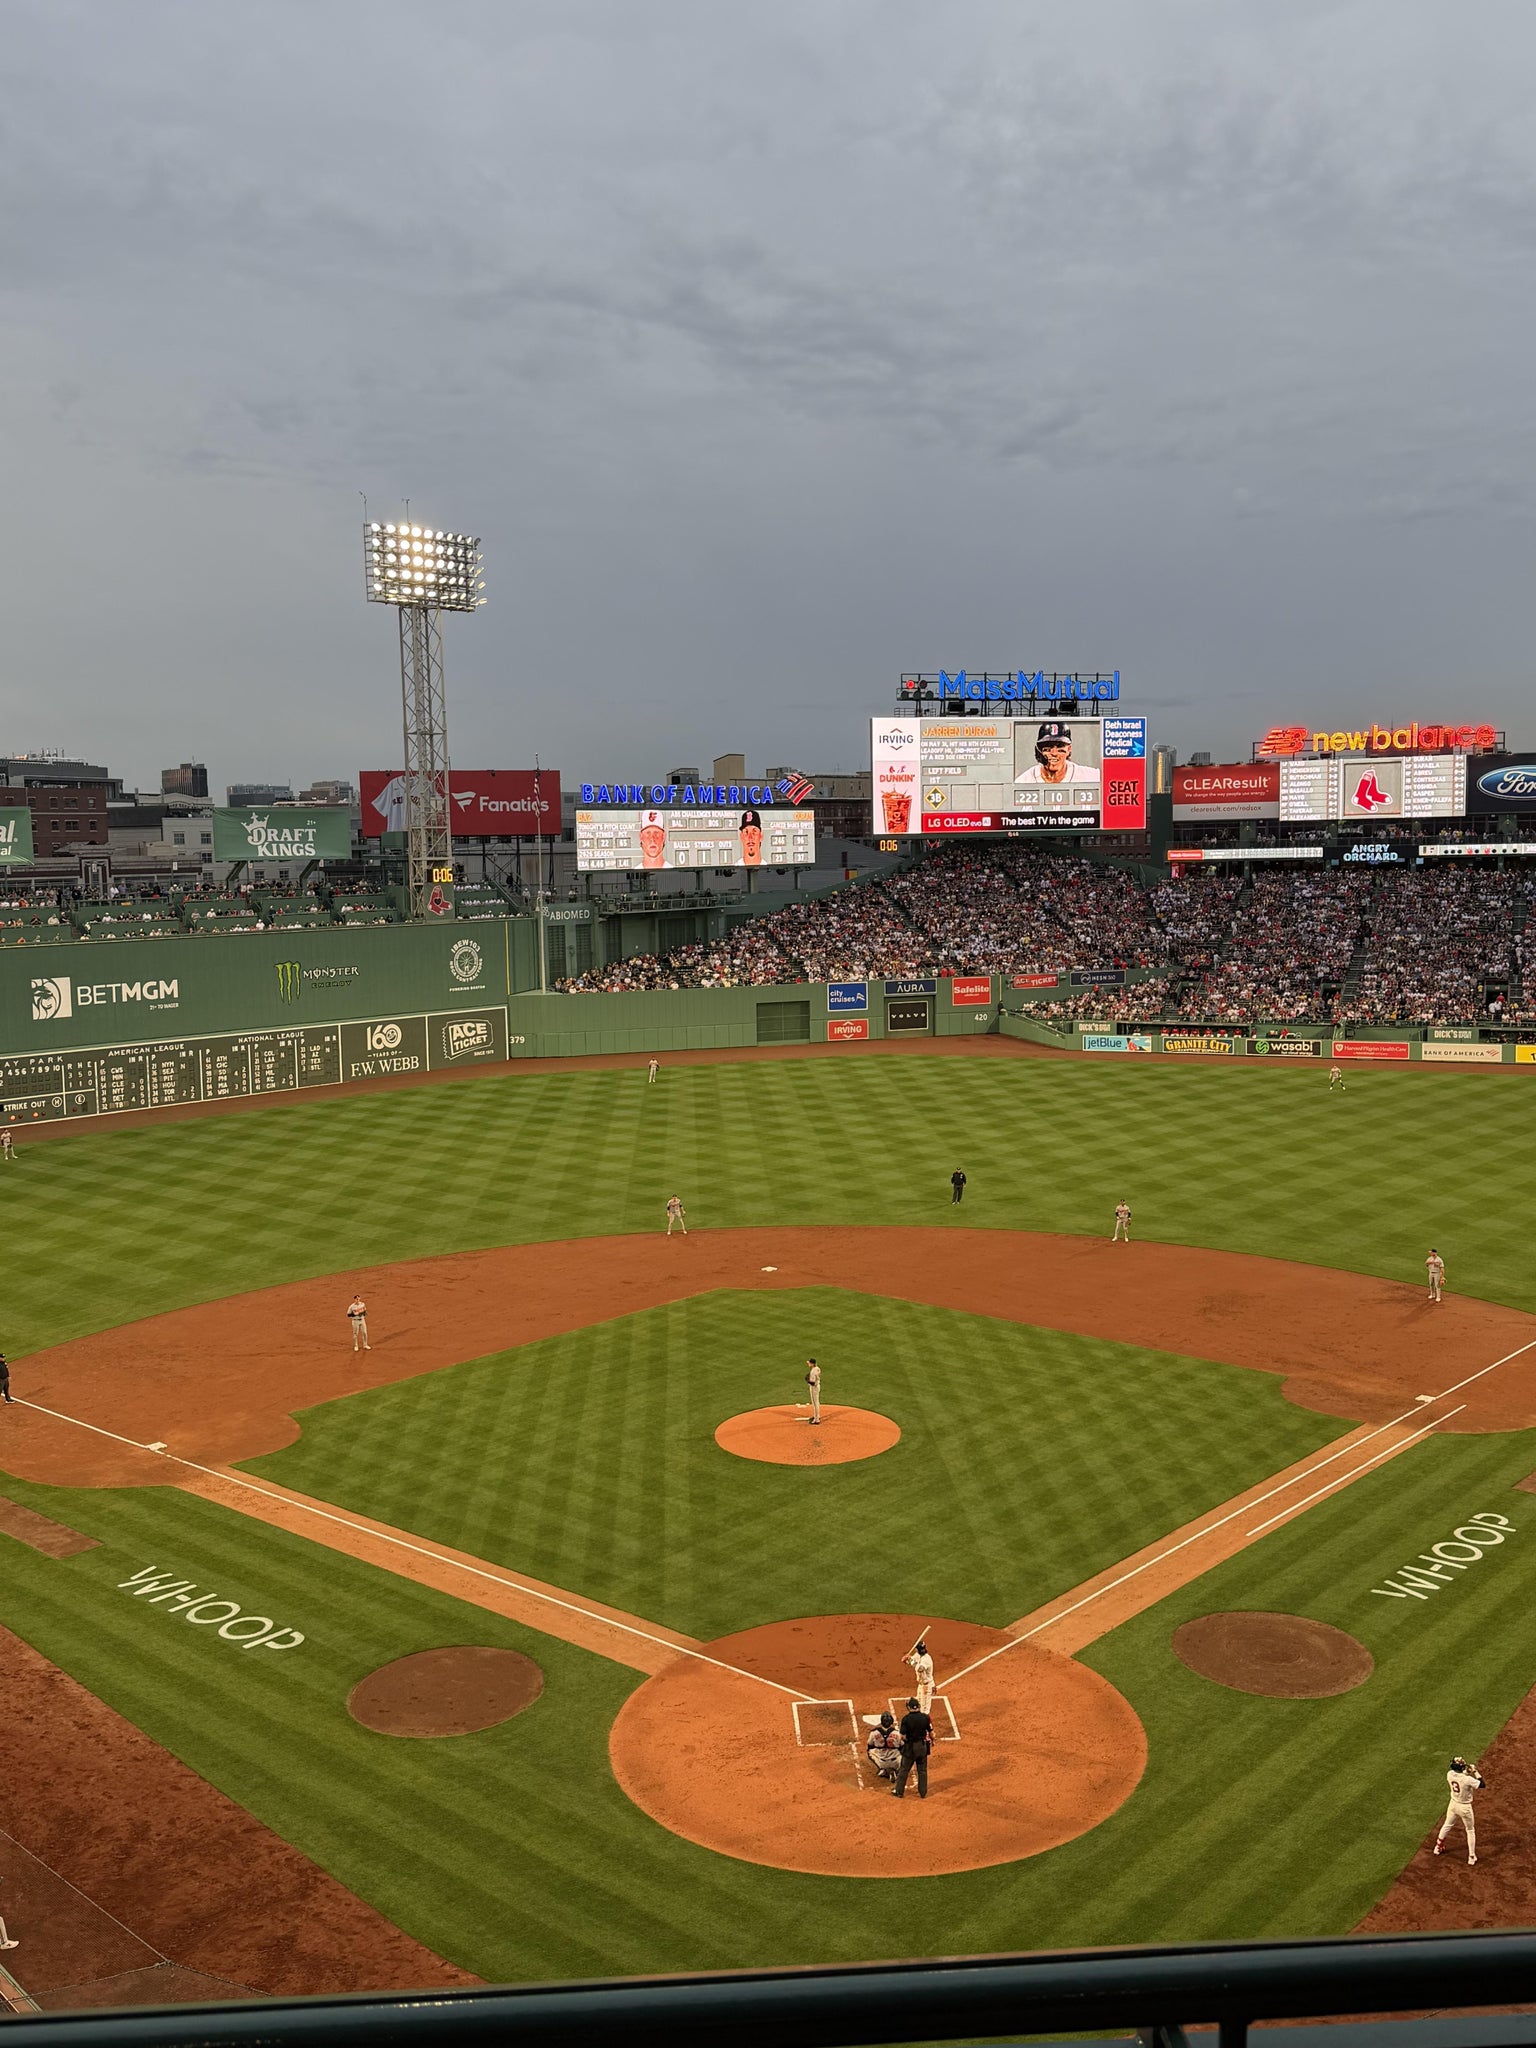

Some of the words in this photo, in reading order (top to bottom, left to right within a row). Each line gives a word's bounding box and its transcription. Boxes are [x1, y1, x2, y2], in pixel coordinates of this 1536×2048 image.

[939, 670, 1119, 699] MassMutual
[1105, 721, 1121, 729] Beth
[1123, 721, 1141, 729] Israel
[922, 726, 960, 737] JARREN
[963, 726, 996, 736] DURAN
[1105, 730, 1142, 738] Deaconess
[1313, 731, 1369, 751] new
[1372, 722, 1496, 749] balance
[879, 735, 914, 743] IRVING
[1105, 738, 1132, 747] Medical
[1105, 748, 1129, 756] Center
[1110, 781, 1138, 792] SEAT
[1183, 776, 1268, 790] CLEAResult
[582, 783, 645, 804] BANK
[650, 784, 677, 804] OF
[683, 785, 774, 804] AMERICA
[930, 794, 942, 803] 3B
[1016, 794, 1038, 803] .222
[1051, 793, 1062, 802] 10
[1080, 792, 1093, 802] 33
[479, 796, 549, 812] Fanatics
[1108, 794, 1139, 806] GEEK
[1190, 805, 1262, 813] clearesult.com/redsox
[928, 819, 940, 827] LG
[944, 818, 970, 827] OLED
[1001, 817, 1016, 826] The
[1018, 817, 1035, 825] best
[1036, 816, 1048, 825] TV
[1049, 816, 1056, 825] in
[1057, 816, 1071, 825] the
[1072, 817, 1095, 826] game
[247, 828, 316, 845] DRAFT
[257, 842, 316, 856] KINGS
[880, 840, 898, 851] 0:06
[1351, 844, 1390, 853] ANGRY
[679, 851, 685, 864] 0
[702, 851, 705, 864] 1
[724, 851, 727, 863] 1
[1343, 852, 1398, 862] ORCHARD
[433, 868, 453, 883] 0:06
[550, 910, 590, 920] ABIOMED
[303, 966, 359, 979] MONSTER
[1031, 976, 1057, 986] TICKET
[77, 979, 179, 1006] BETMGM
[954, 986, 990, 994] Safelite
[974, 1013, 988, 1021] 420
[452, 1022, 487, 1041] ACE
[834, 1025, 862, 1034] IRVING
[1078, 1023, 1099, 1031] DICK'S
[238, 1035, 274, 1044] NATIONAL
[277, 1031, 305, 1039] LEAGUE
[509, 1036, 525, 1044] 379
[1434, 1030, 1458, 1039] DICK'S
[453, 1034, 488, 1051] TICKET
[1087, 1037, 1122, 1049] jetBlue
[1165, 1040, 1208, 1051] GRANITE
[1210, 1040, 1232, 1052] CITY
[1270, 1041, 1313, 1051] wasabi
[108, 1047, 150, 1057] AMERICAN
[154, 1043, 185, 1052] LEAGUE
[29, 1056, 64, 1065] PARK
[351, 1062, 376, 1077] F.W.
[379, 1055, 420, 1073] WEBB
[3, 1102, 28, 1112] STRIKE
[31, 1100, 46, 1108] OUT
[1370, 1512, 1516, 1600] WHOOP
[117, 1565, 305, 1649] WHOOP
[1451, 1781, 1460, 1793] 3
